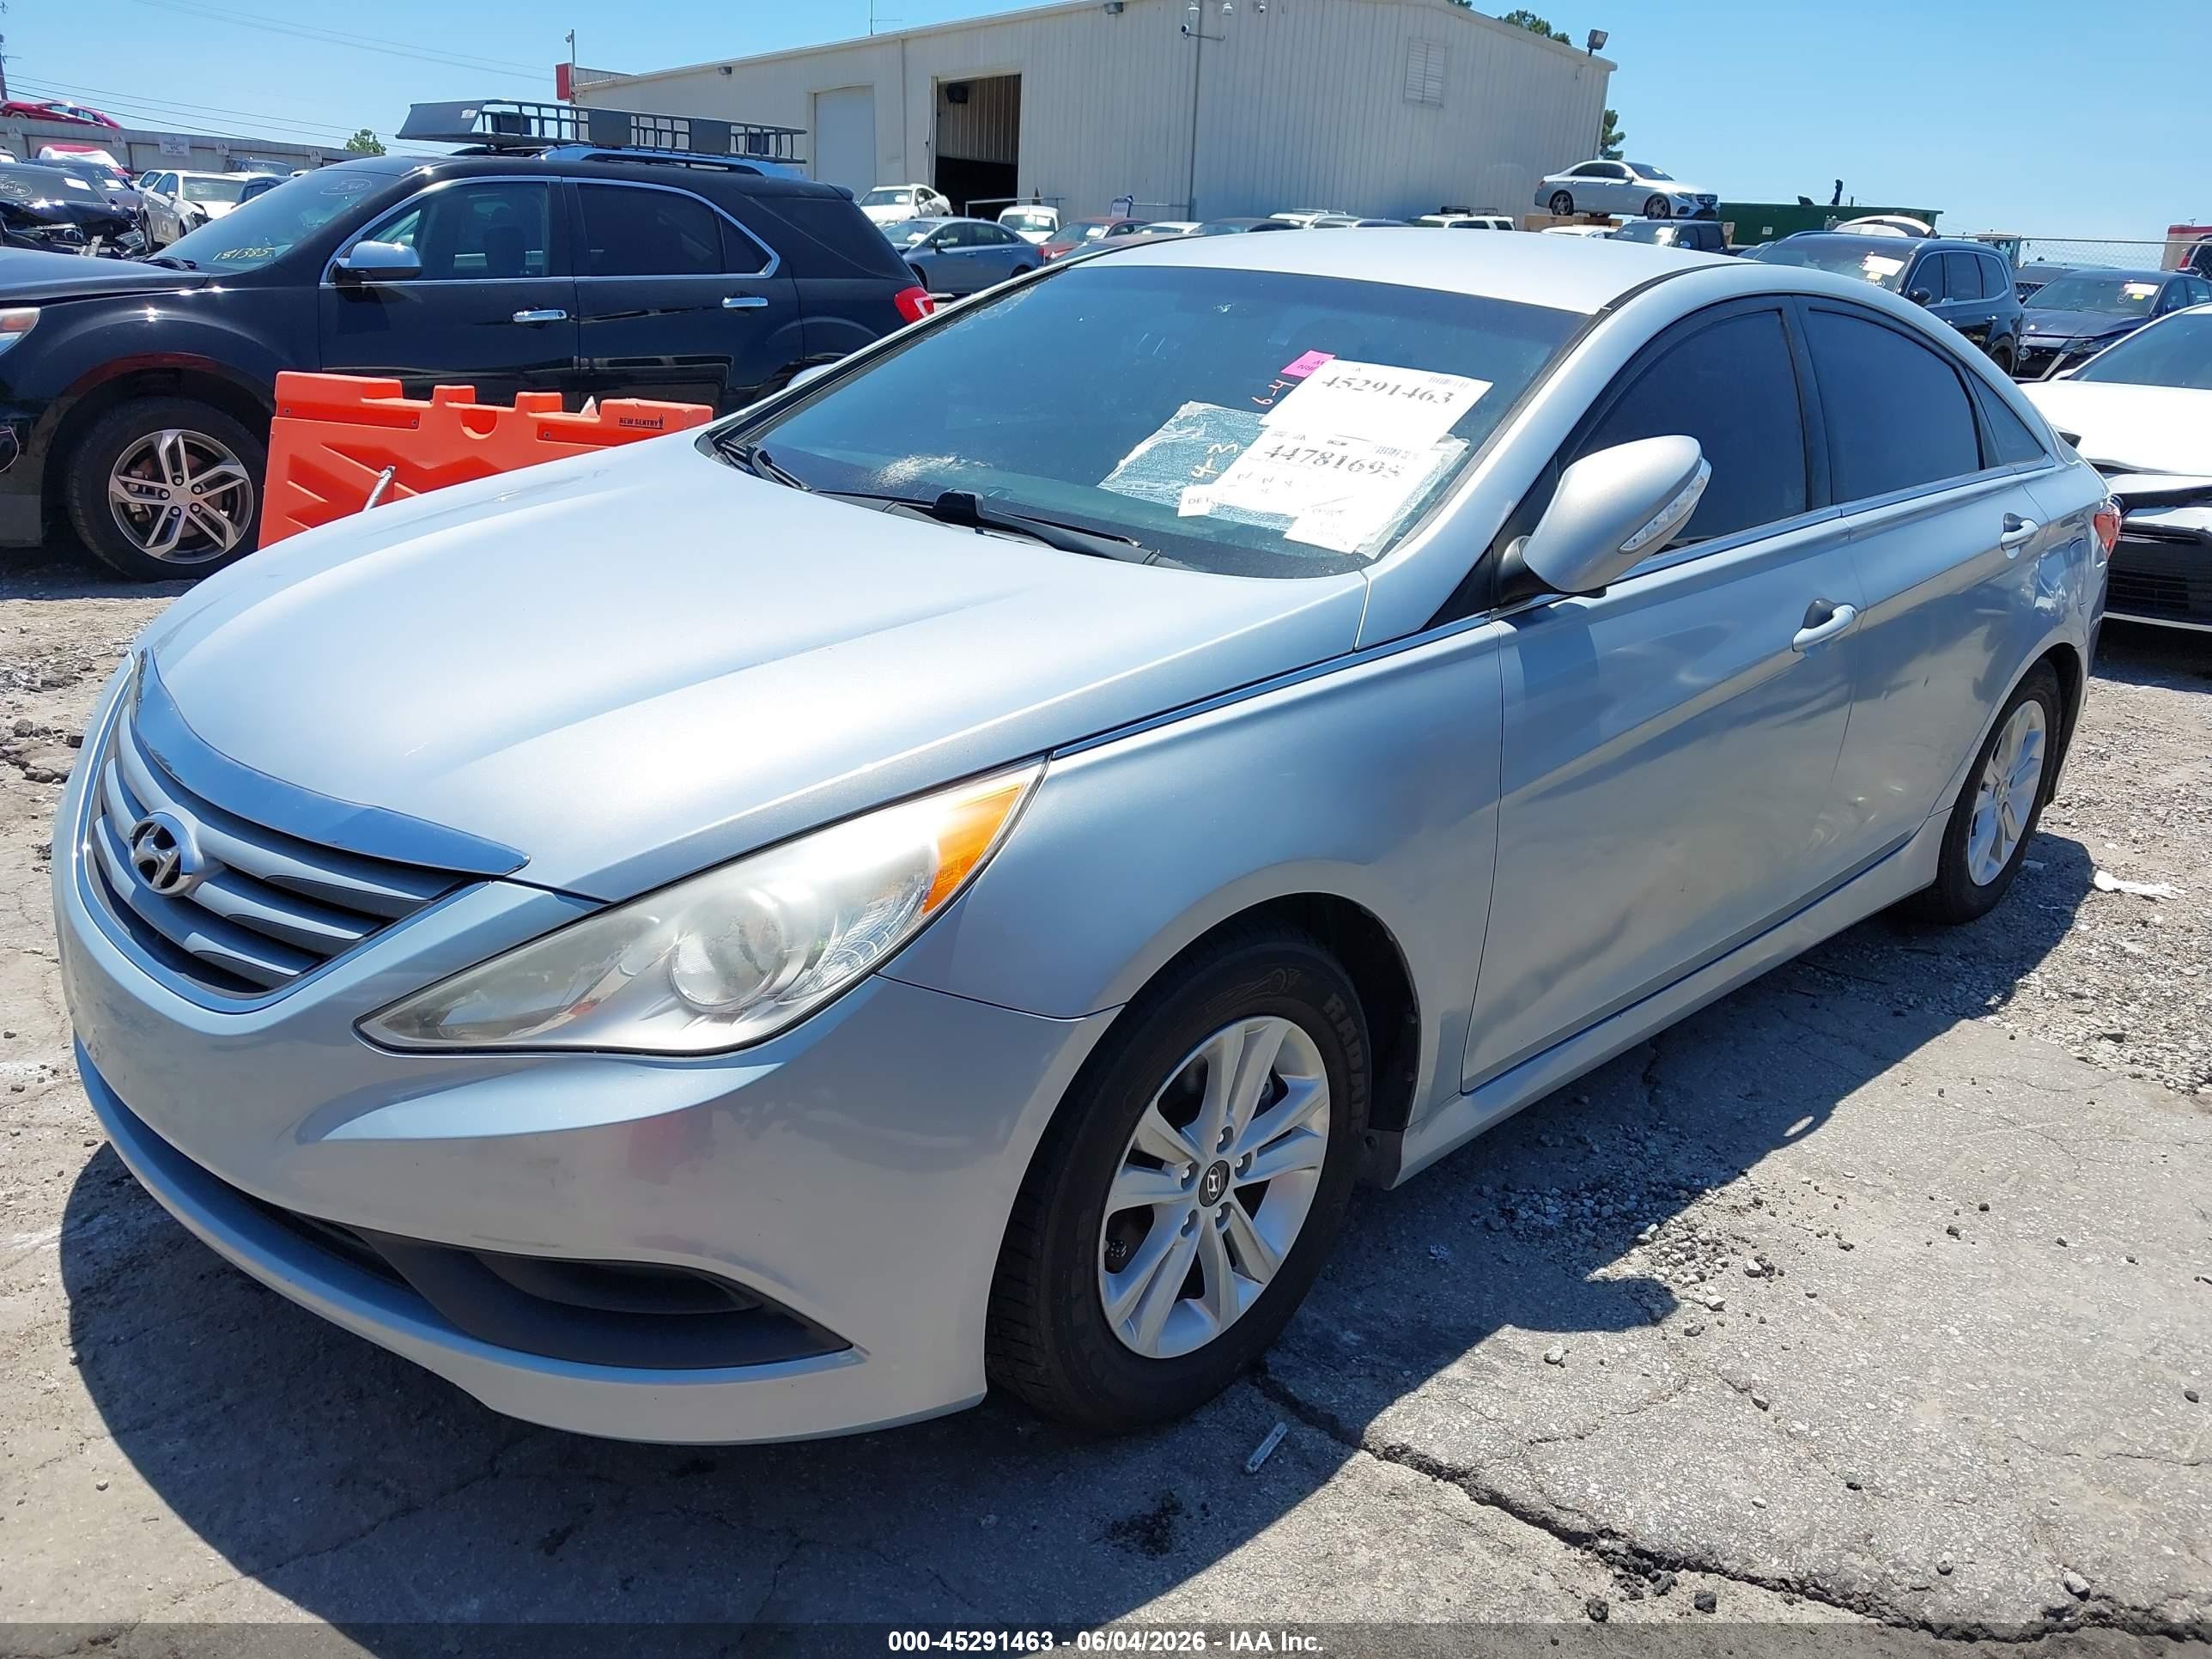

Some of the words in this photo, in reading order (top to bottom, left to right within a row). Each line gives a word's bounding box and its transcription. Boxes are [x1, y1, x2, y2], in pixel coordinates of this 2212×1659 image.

[1321, 375, 1455, 404] 45291463
[619, 416, 634, 425] NEW
[635, 418, 659, 427] SENTRY
